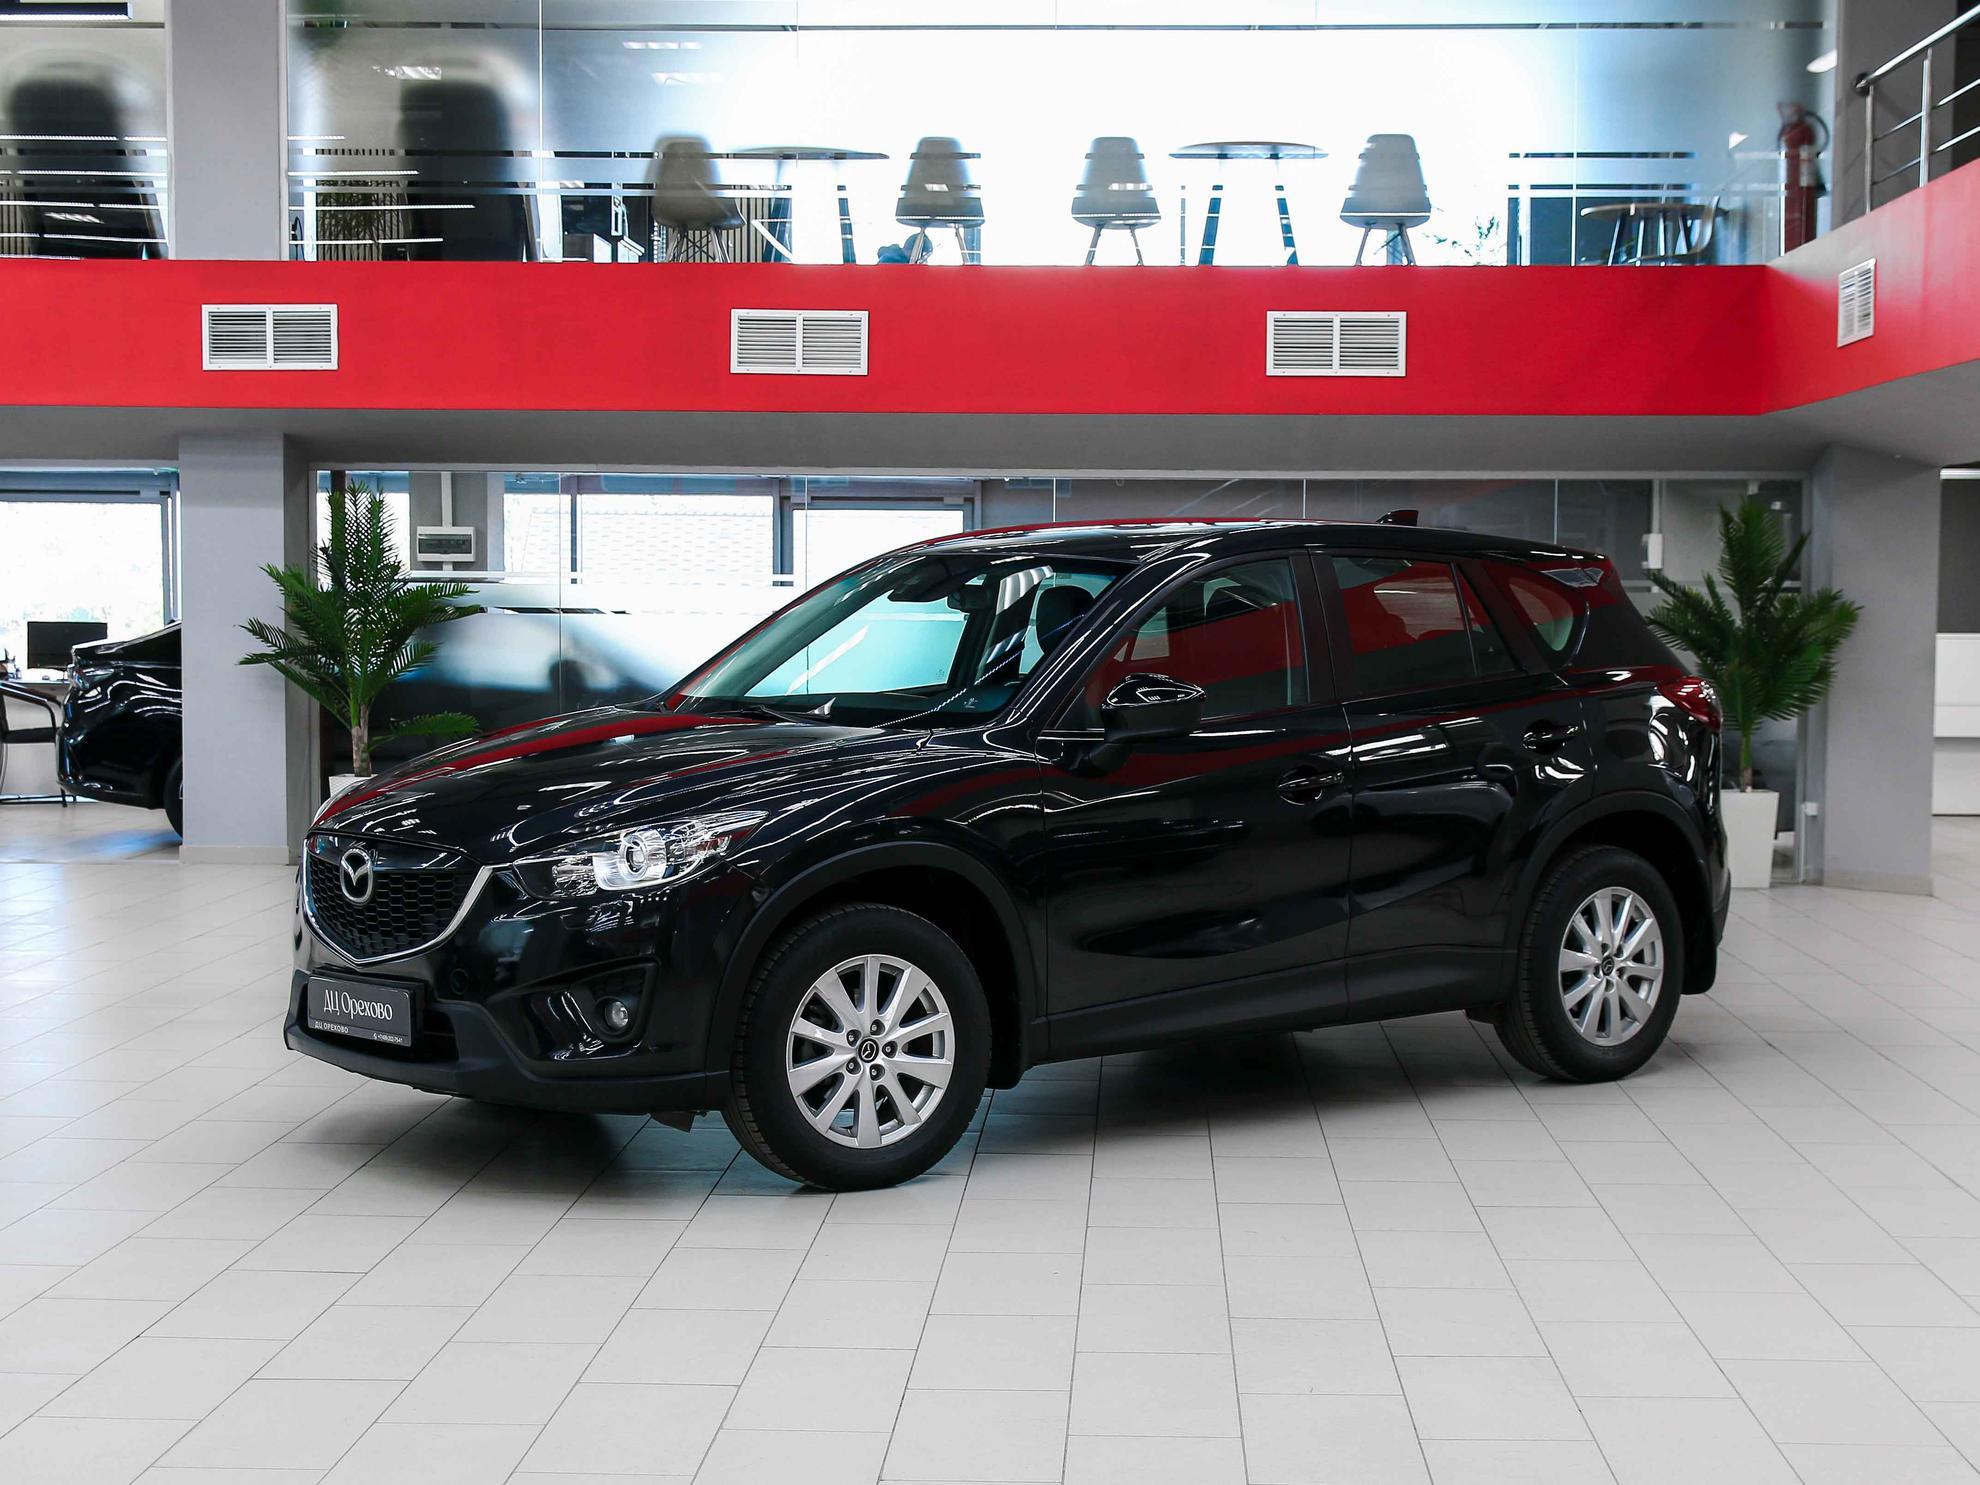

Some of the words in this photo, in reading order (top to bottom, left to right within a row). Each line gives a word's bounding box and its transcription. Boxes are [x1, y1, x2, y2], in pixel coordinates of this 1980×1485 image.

[323, 989, 340, 1016] ДЦ
[341, 991, 393, 1020] Орехово
[314, 1021, 323, 1029] ДЦ
[323, 1023, 349, 1033] ОРЕХОВО
